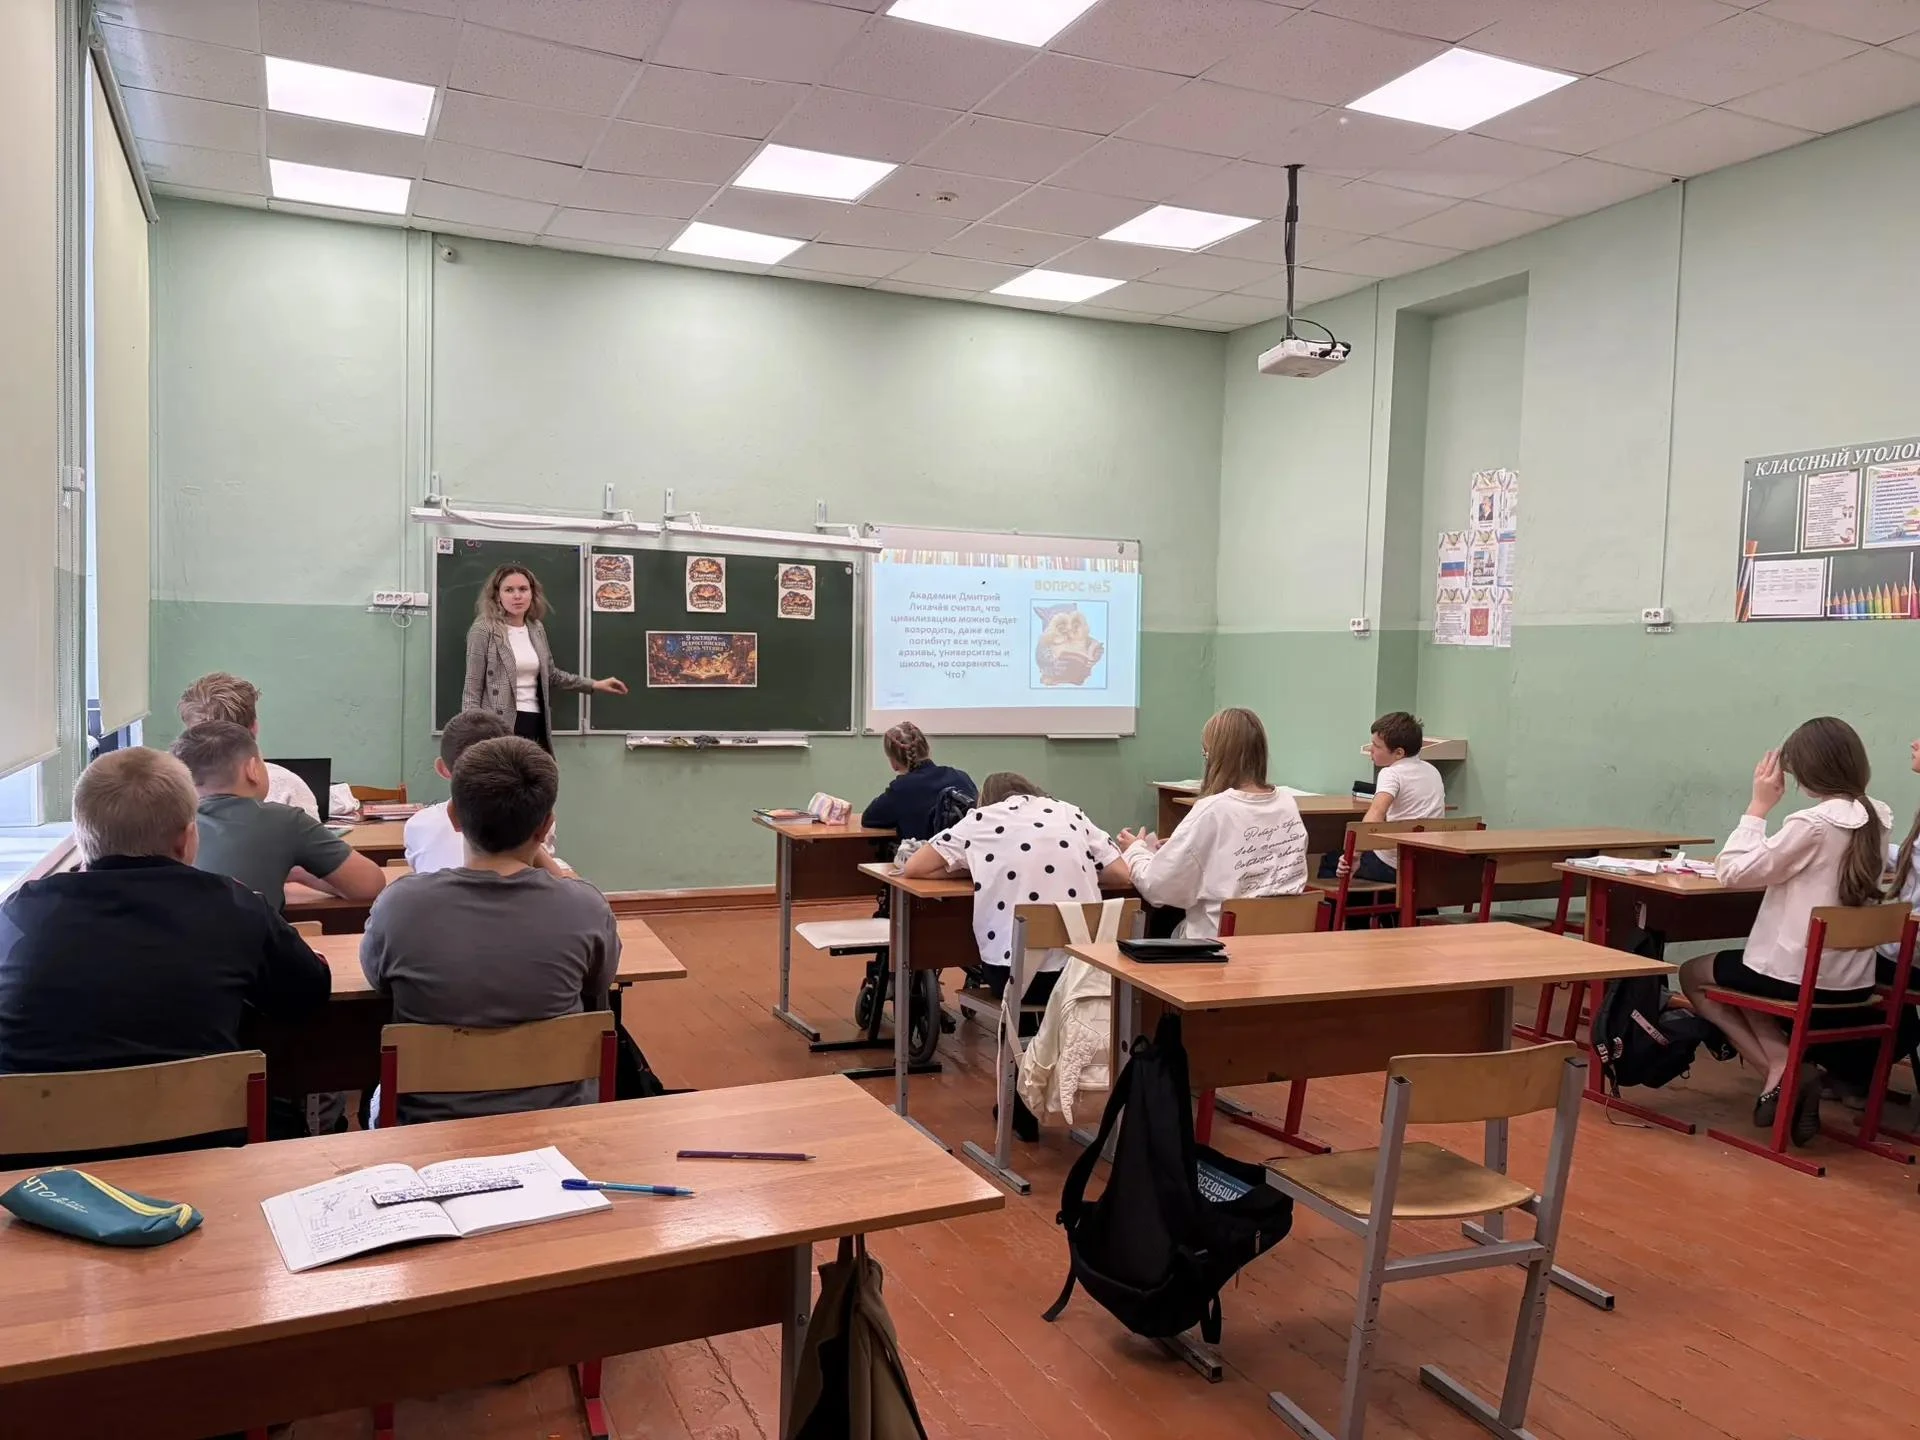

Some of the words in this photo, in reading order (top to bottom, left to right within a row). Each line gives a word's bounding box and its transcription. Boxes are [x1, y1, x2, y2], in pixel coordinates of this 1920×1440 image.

[1755, 447, 1850, 476] КЛАССНЫЙ
[1034, 580, 1085, 592] ВОПРОС
[909, 591, 957, 601] Академик
[959, 592, 1000, 602] Дмитрий
[909, 603, 949, 612] Лихачёв
[950, 604, 984, 613] считал,
[890, 615, 956, 625] цивилизацию
[992, 615, 1017, 626] будет
[904, 627, 956, 636] возродить,
[958, 627, 982, 636] даже
[909, 636, 951, 647] погибнут
[970, 639, 1001, 647] музеи,
[898, 649, 937, 658] архивы,
[939, 649, 1002, 658] университеты
[899, 661, 935, 669] школы,
[945, 671, 966, 679] Что?
[23, 1175, 57, 1197] ЧТО
